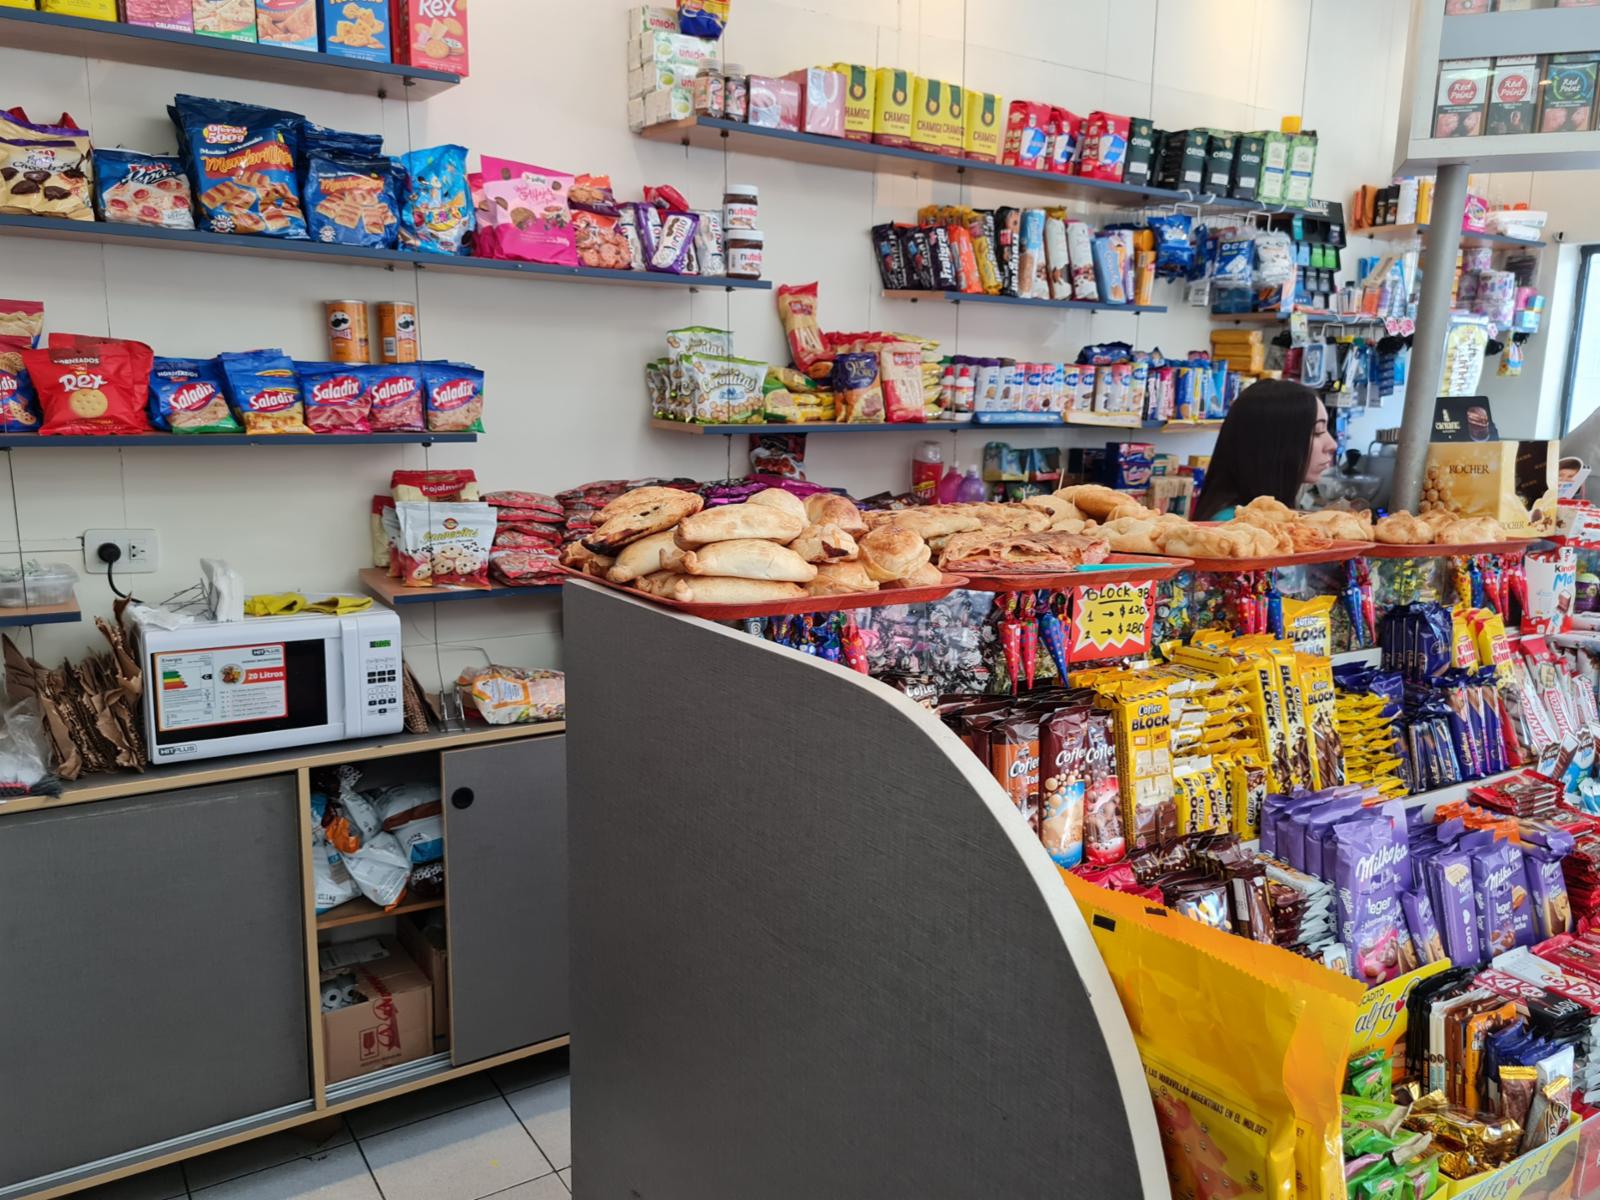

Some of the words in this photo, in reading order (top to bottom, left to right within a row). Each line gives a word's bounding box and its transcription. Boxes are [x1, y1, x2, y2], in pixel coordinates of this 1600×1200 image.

[845, 107, 870, 120] HAMIGO
[58, 374, 108, 392] Rex
[313, 377, 359, 402] Saladix
[372, 378, 415, 401] Saladix
[433, 380, 475, 406] Saladix
[168, 382, 216, 411] Saladix
[249, 391, 295, 411] Saladix
[1449, 464, 1490, 475] ROCHER
[1501, 521, 1525, 530] OCHER
[1083, 586, 1132, 601] BLOCK
[1287, 626, 1326, 643] BLOCK
[247, 671, 258, 680] 20
[260, 669, 284, 679] Litros
[1259, 669, 1277, 729] BLOCK
[1280, 665, 1297, 724] BLOCK
[1308, 692, 1335, 705] BLOCK
[1131, 715, 1170, 732] BLOCK
[1183, 777, 1198, 833] BLOCK
[1202, 771, 1220, 825] BLOCK
[1484, 866, 1513, 890] Milka
[1366, 897, 1393, 915] leger
[1158, 1072, 1190, 1097] MARAVILLAS
[1225, 1108, 1234, 1118] EN
[1234, 1114, 1241, 1125] EL
